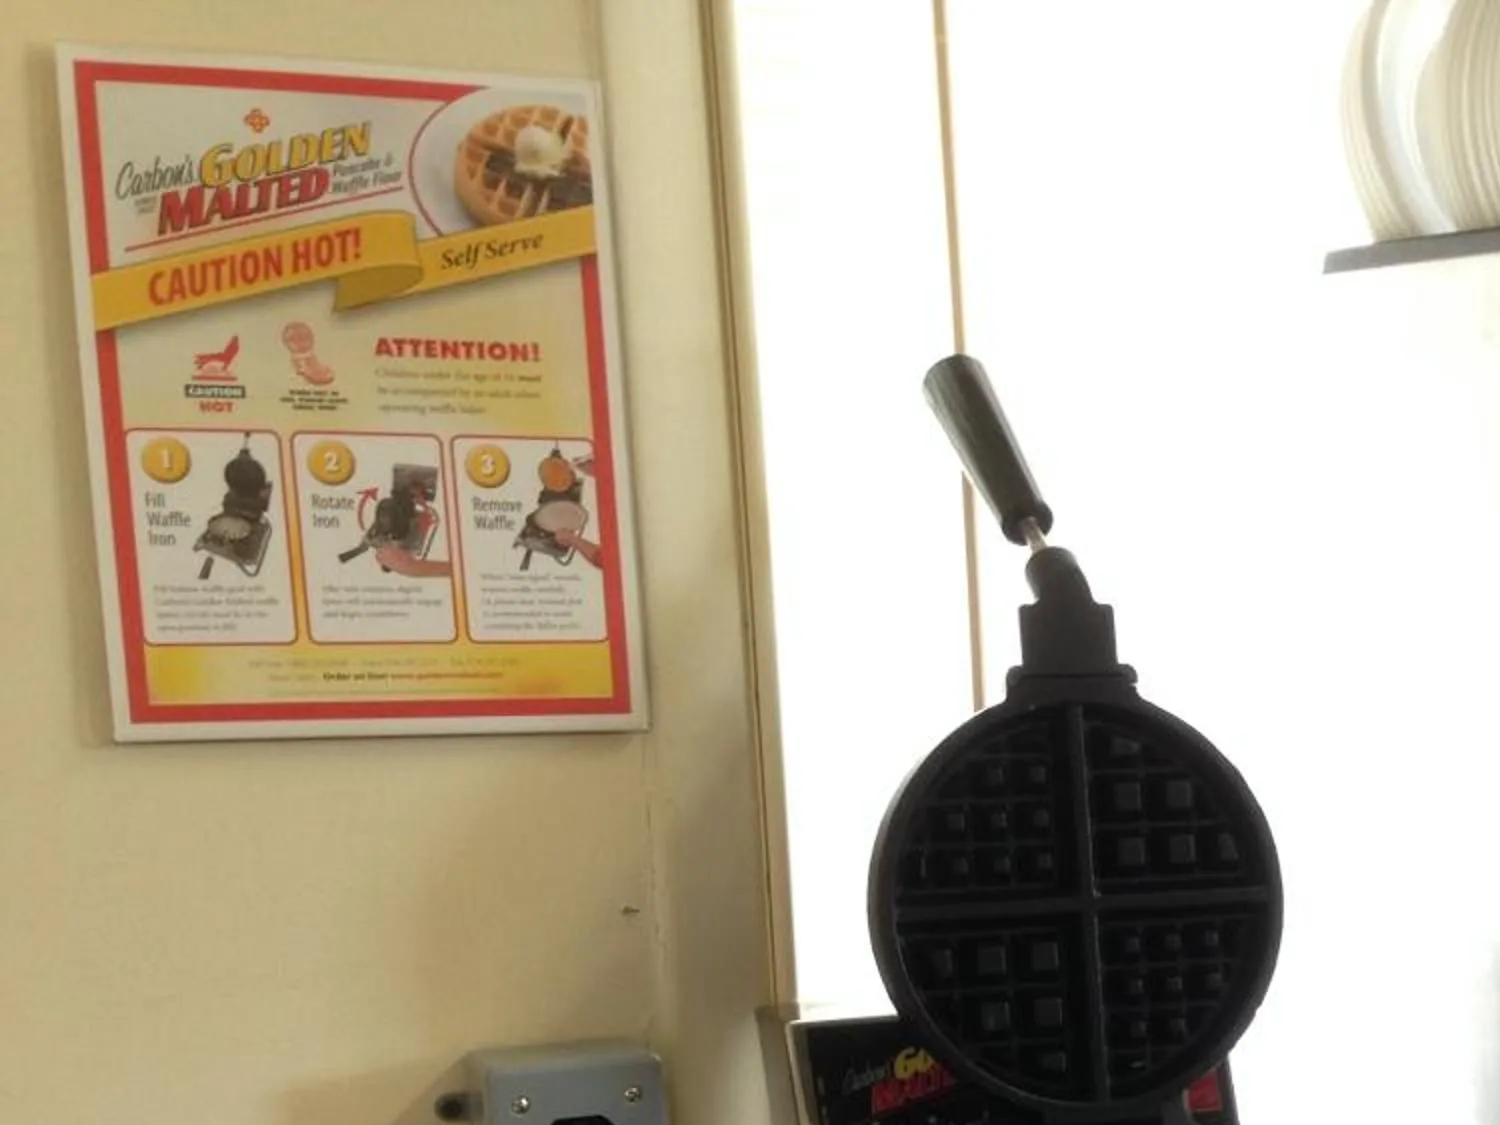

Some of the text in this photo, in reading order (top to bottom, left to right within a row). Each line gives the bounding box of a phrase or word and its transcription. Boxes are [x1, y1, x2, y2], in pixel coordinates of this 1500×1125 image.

[115, 120, 371, 200] Carbon's GOLDEN
[158, 167, 330, 236] MALTED
[440, 231, 544, 270] Self Serve
[148, 228, 361, 306] CAUTION HOT!
[375, 337, 541, 362] ATTENTION!
[188, 386, 243, 397] CAUTION
[199, 401, 234, 413] HOT
[160, 452, 172, 469] 1
[322, 452, 340, 471] 2
[480, 455, 497, 474] 3
[144, 491, 167, 509] Fill
[311, 493, 356, 512] Rotate
[471, 496, 523, 514] Remove
[146, 510, 193, 529] Waffle
[310, 513, 341, 530] Iron
[473, 514, 516, 532] Waffle
[147, 530, 178, 548] Iron
